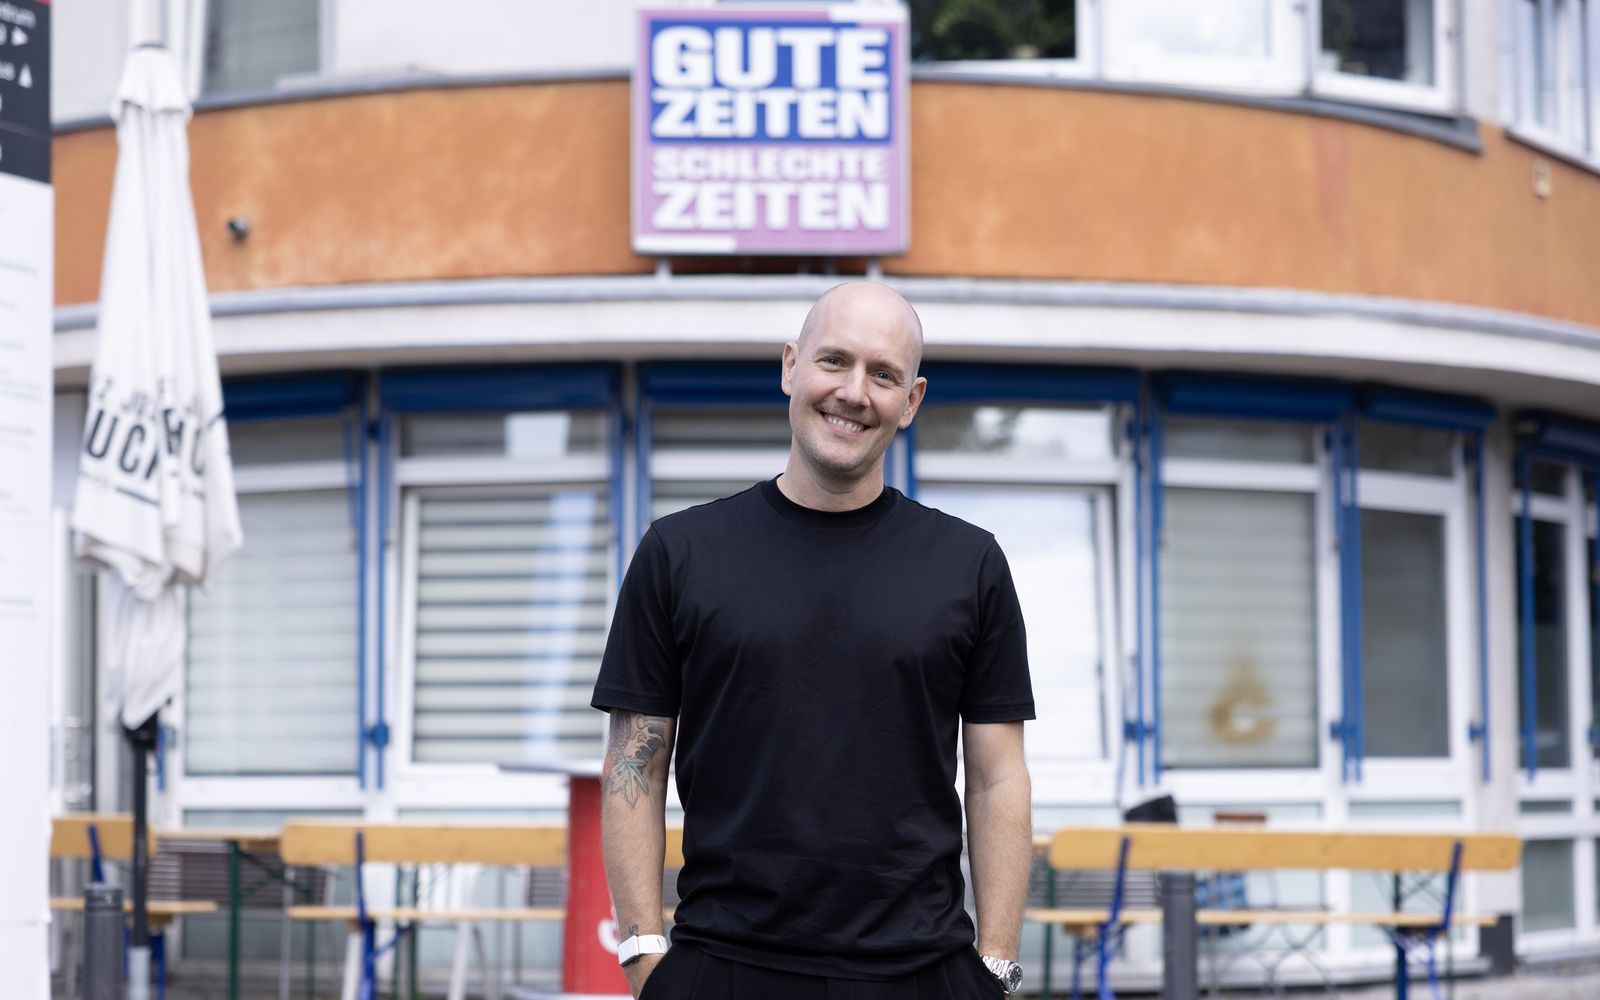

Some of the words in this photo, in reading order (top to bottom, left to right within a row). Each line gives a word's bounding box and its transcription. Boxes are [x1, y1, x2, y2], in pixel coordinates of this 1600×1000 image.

[651, 26, 889, 90] GUTE
[651, 88, 889, 139] ZEITEN
[651, 148, 889, 181] SCHLECHTE
[651, 182, 889, 231] ZEITEN
